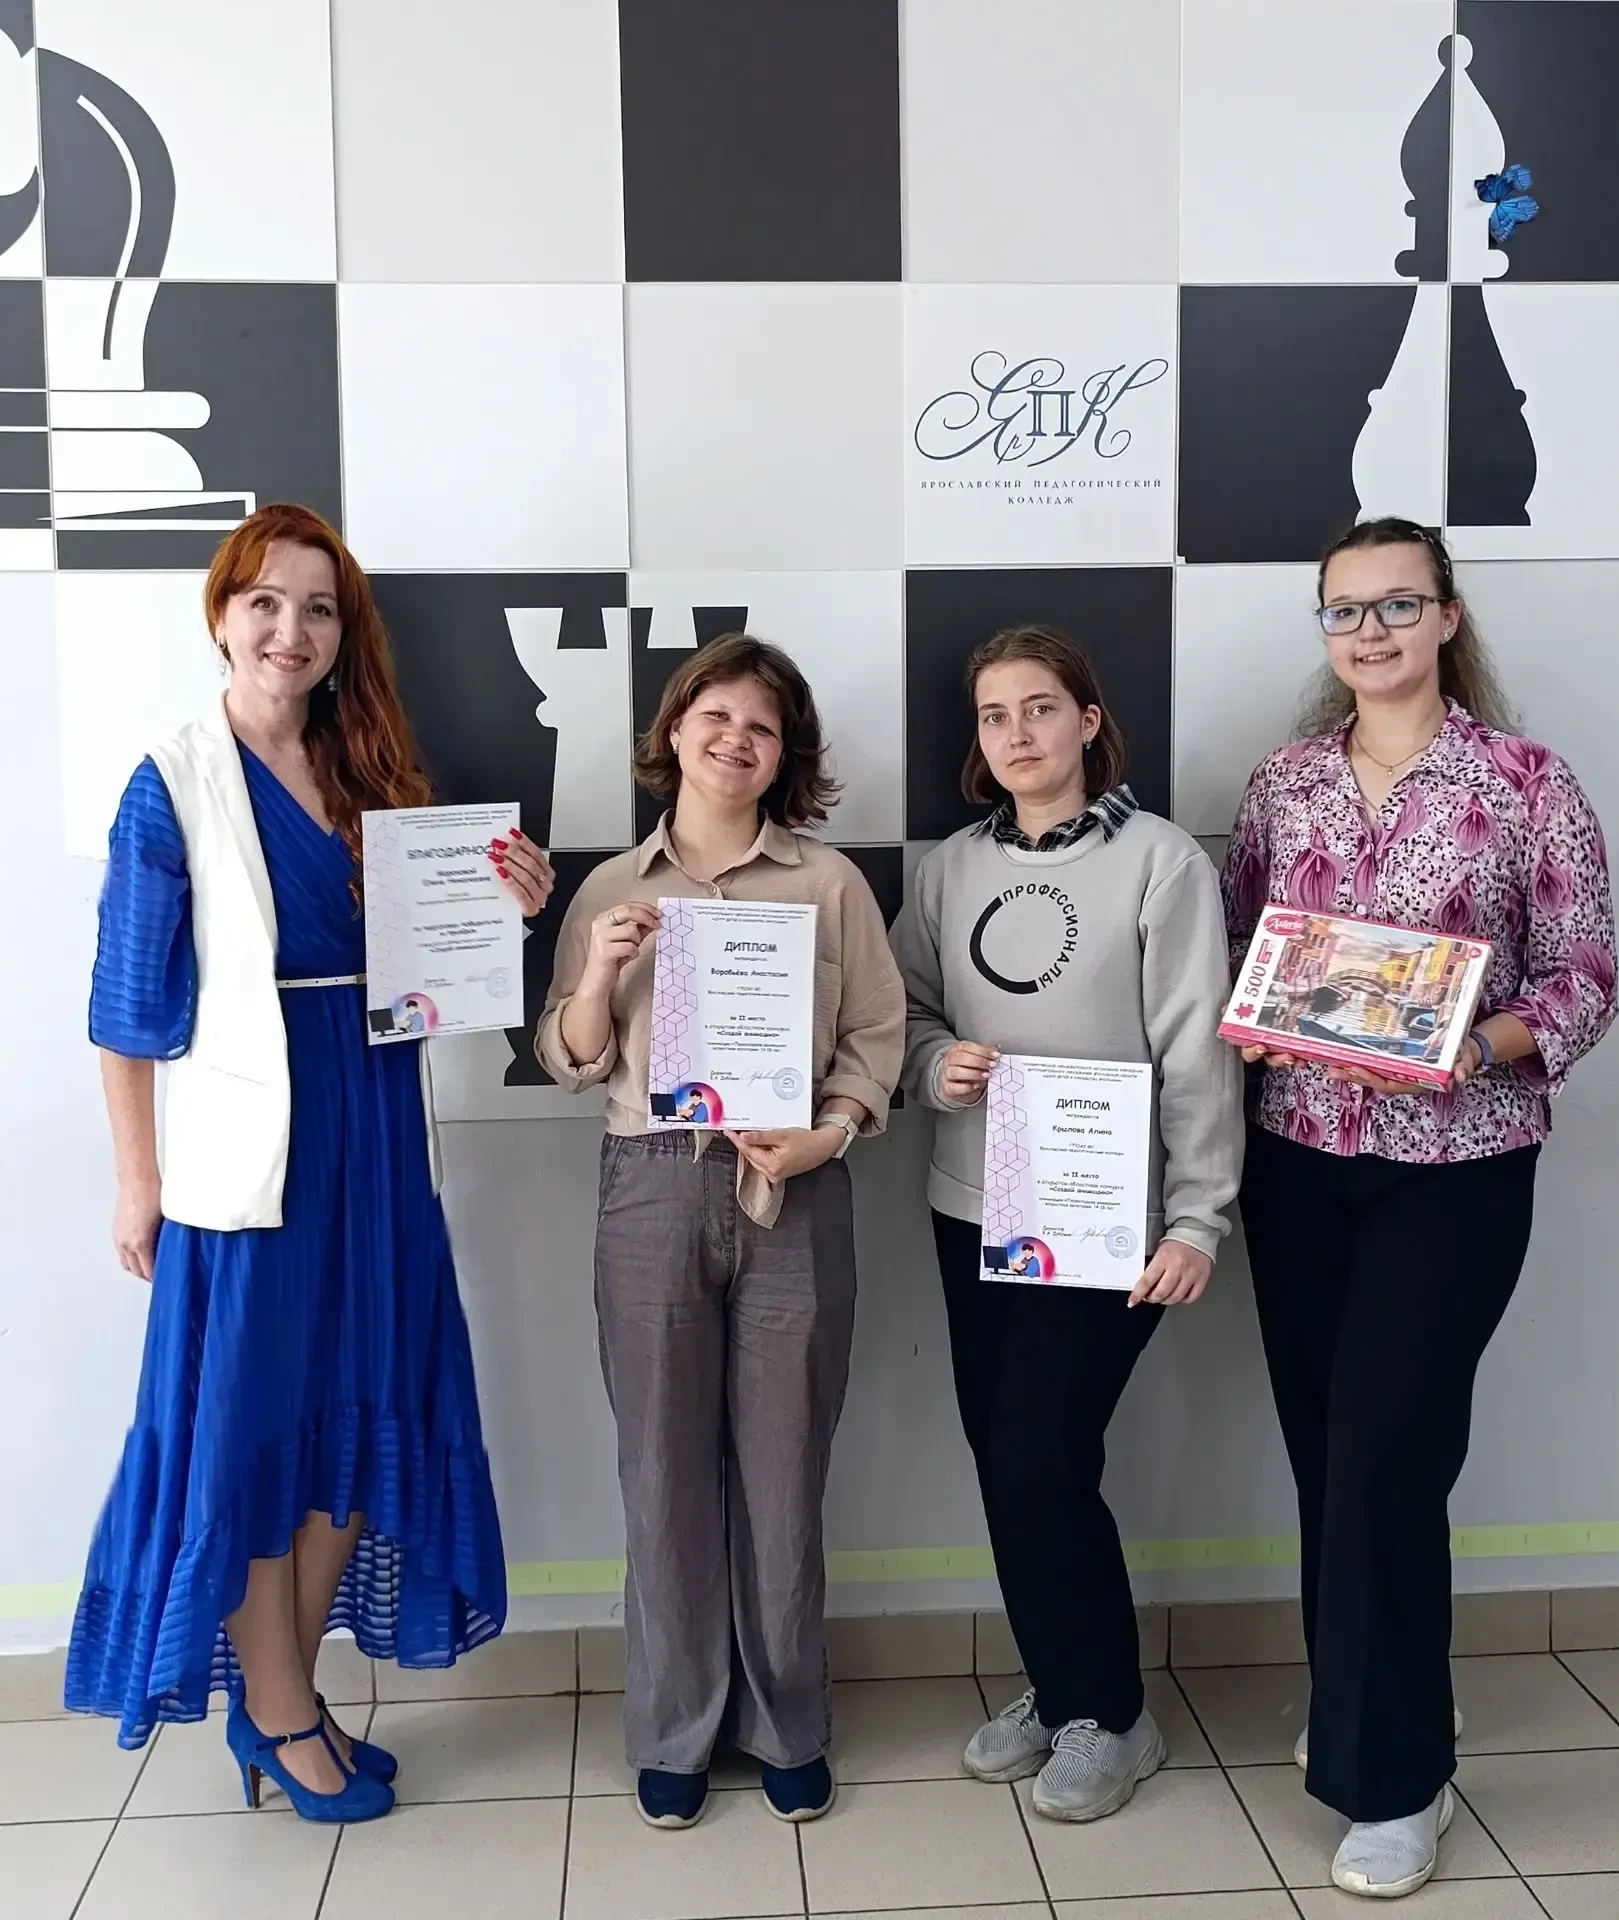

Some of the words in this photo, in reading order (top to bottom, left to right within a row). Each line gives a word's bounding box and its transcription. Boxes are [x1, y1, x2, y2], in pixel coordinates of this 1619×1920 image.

[920, 479, 1022, 489] ЯРОСЛАВСКИЙ
[1033, 479, 1162, 489] ПЕДАГОГИЧЕСКИЙ
[1008, 495, 1075, 505] КОЛЛЕДЖ
[1002, 883, 1079, 989] ПРОФЕССИОНАЛЫ
[724, 941, 778, 953] ДИПЛОМ
[711, 967, 749, 977] Воробьёва
[1244, 965, 1266, 998] 500
[1055, 1098, 1111, 1111] ДИПЛОМ
[1052, 1125, 1085, 1134] Крылова
[1088, 1128, 1112, 1136] Алина
